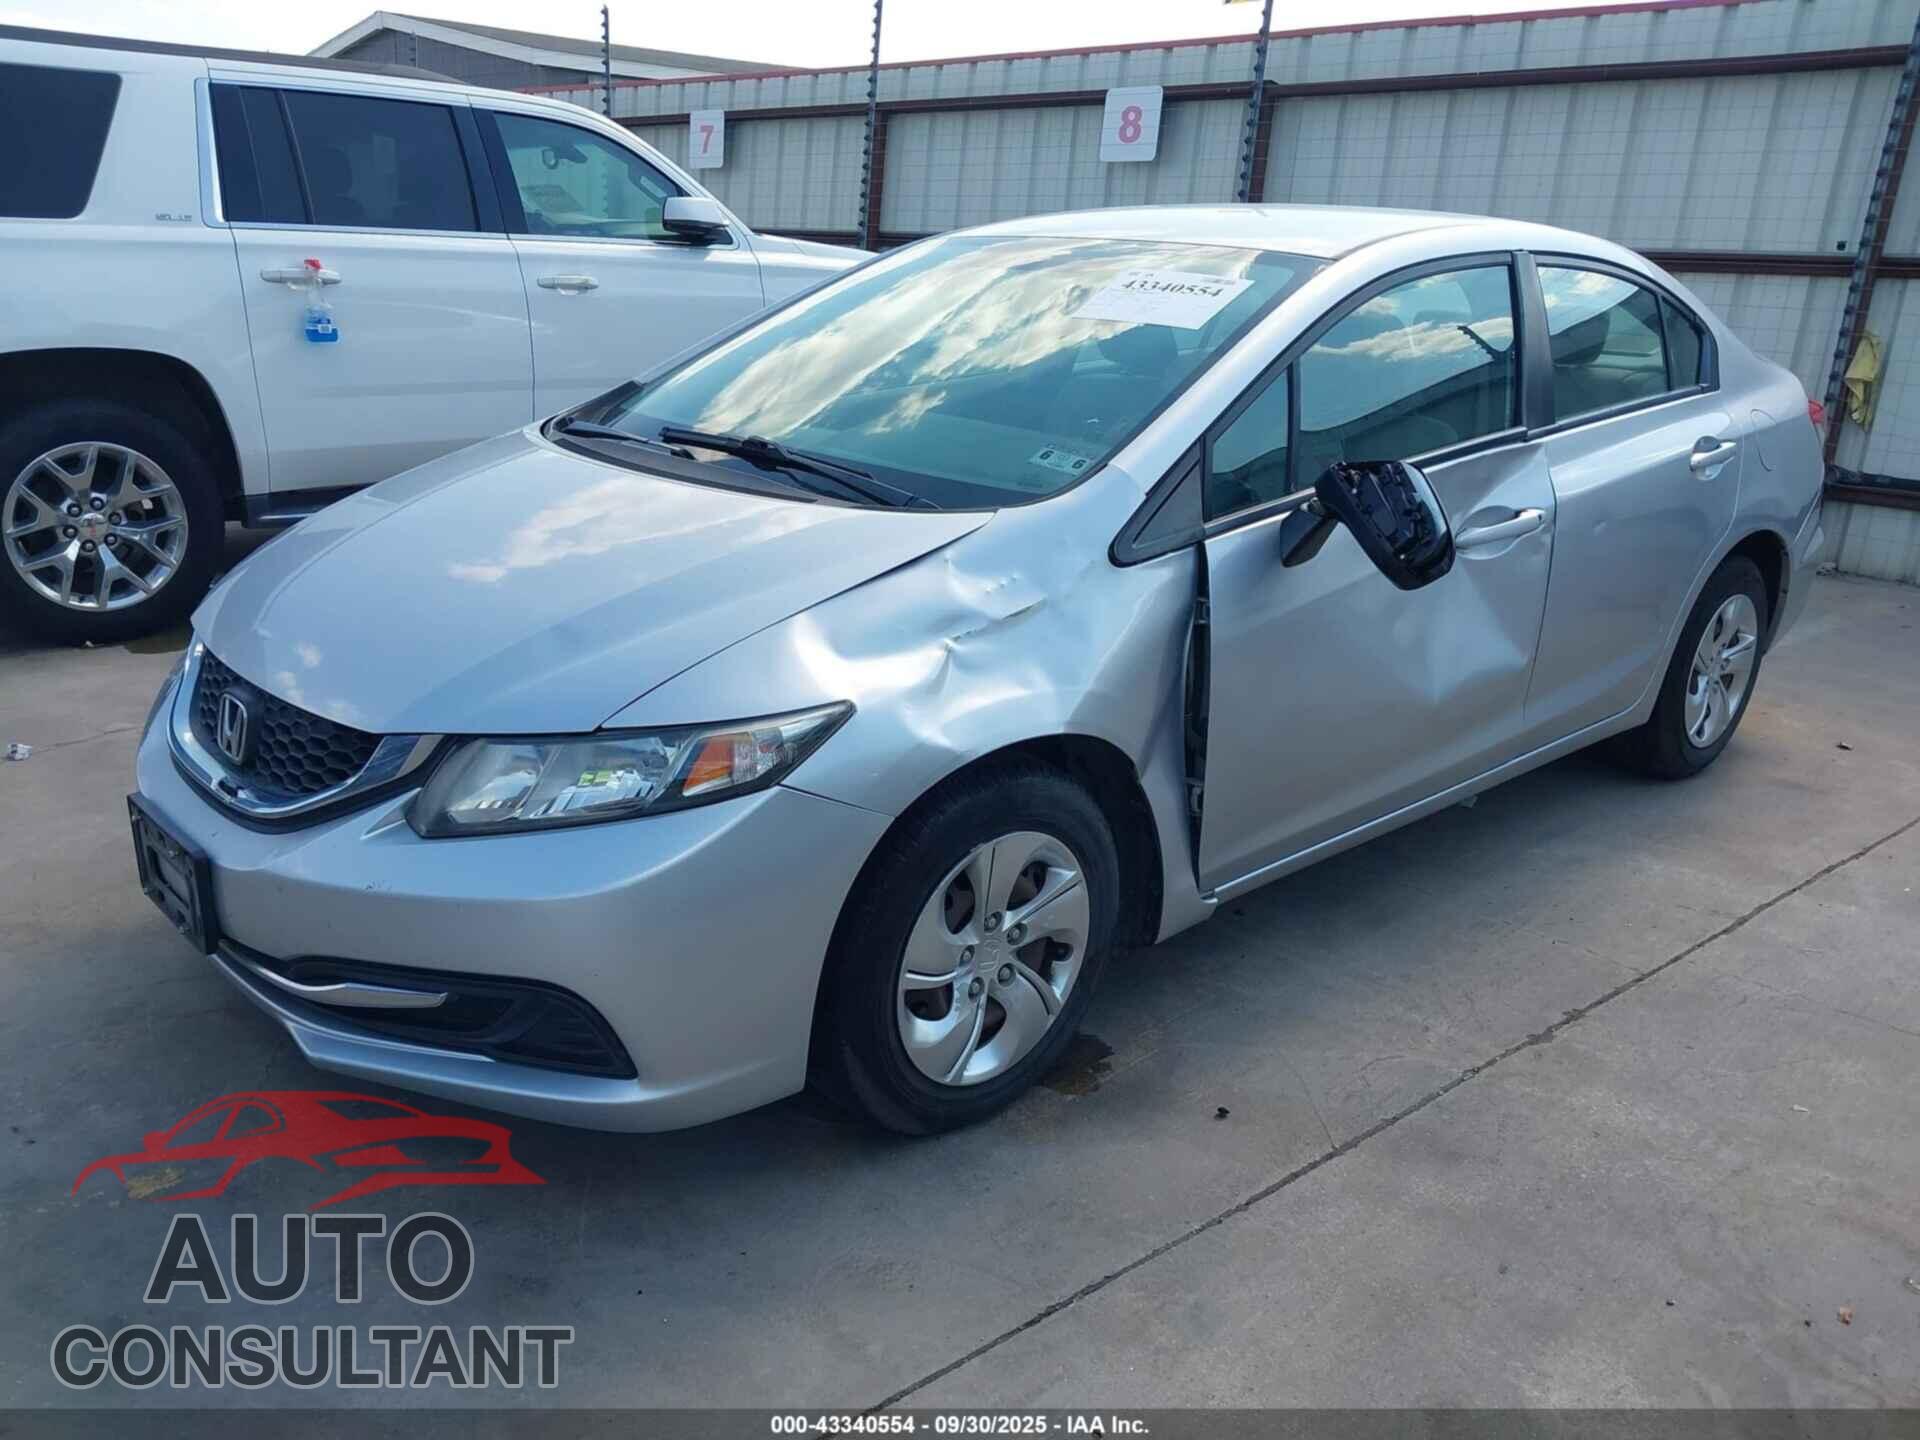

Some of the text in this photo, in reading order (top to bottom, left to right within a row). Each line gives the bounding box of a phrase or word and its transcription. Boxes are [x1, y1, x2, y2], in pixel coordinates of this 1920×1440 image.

[699, 124, 714, 154] 7
[1118, 105, 1143, 144] 8
[1121, 279, 1224, 297] 43340554
